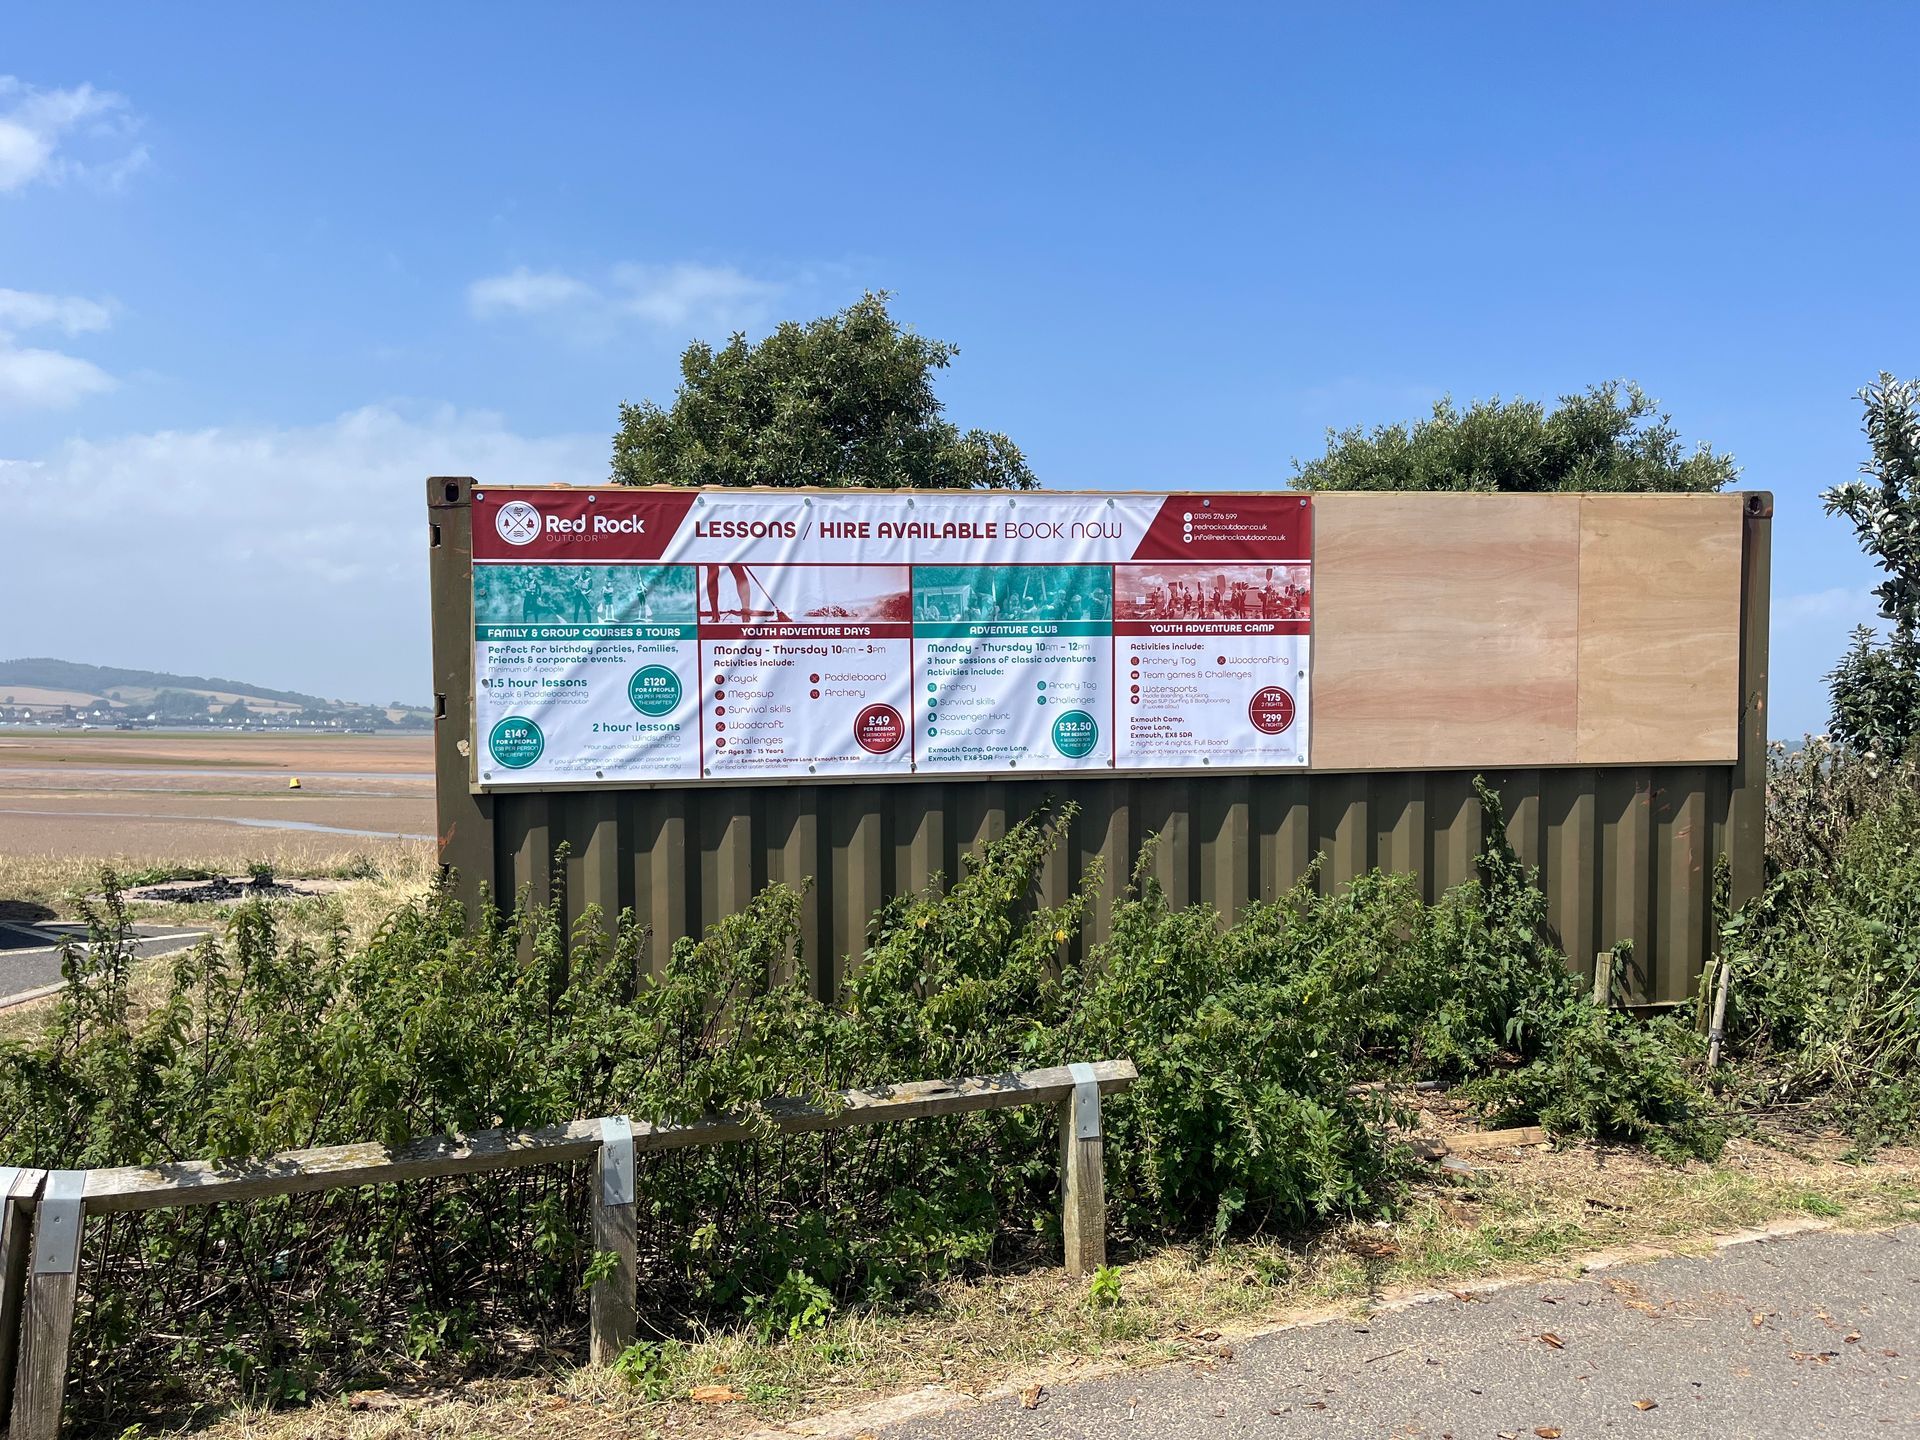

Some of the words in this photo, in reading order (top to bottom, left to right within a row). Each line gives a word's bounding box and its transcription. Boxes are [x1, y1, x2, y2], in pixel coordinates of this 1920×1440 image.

[545, 514, 586, 533] Red
[594, 514, 645, 533] Rock
[695, 521, 796, 539] LESSONS
[820, 521, 870, 539] HIRE
[877, 522, 998, 539] AVAILABLE
[1004, 522, 1064, 539] BOOK
[1071, 522, 1122, 539] NOW
[546, 534, 598, 542] OUTDOOR
[1194, 533, 1286, 541] info@redrockoutdoor.co.uk
[488, 628, 528, 637] FAMILY
[531, 628, 538, 637] &
[541, 628, 580, 637] GROUP
[582, 628, 633, 637] COURSES
[636, 628, 642, 636] &
[645, 628, 681, 636] TOURS
[741, 627, 777, 636] YOUTH
[779, 627, 841, 636] ADVENTURE
[843, 627, 871, 636] DAYS
[969, 626, 1028, 635] ADVENTURE
[1030, 625, 1058, 634] CLUB
[1150, 624, 1183, 633] YOUTH
[1185, 624, 1242, 632] ADVENTURE
[1244, 624, 1275, 632] CAMP
[488, 645, 528, 654] Perfect
[530, 645, 547, 653] for
[549, 645, 593, 655] birthday
[596, 644, 635, 655] parties,
[637, 644, 679, 653] families,
[713, 645, 762, 657] Monday
[772, 645, 828, 656] Thursday
[927, 643, 972, 654] Monday
[981, 642, 1033, 653] Thursday
[488, 656, 525, 664] friends
[527, 656, 533, 664] &
[536, 655, 588, 665] corporate
[590, 655, 626, 663] events.
[713, 659, 758, 667] Activities
[760, 658, 795, 666] include:
[927, 657, 932, 665] 3
[934, 656, 957, 664] hour
[959, 655, 996, 664] sessions
[998, 655, 1009, 664] of
[1011, 655, 1042, 663] classic
[1044, 655, 1097, 663] adventures
[1142, 657, 1178, 666] Archery
[1180, 656, 1196, 666] Tag
[1228, 655, 1289, 665] Woodcrafting
[523, 665, 532, 673] of
[540, 665, 564, 674] people
[927, 668, 969, 676] Activities
[970, 667, 1004, 675] include:
[727, 674, 758, 684] Kayak
[824, 673, 887, 681] Paddleboard
[1142, 671, 1165, 679] Team
[1166, 672, 1196, 680] games
[1204, 670, 1252, 680] Challenges
[488, 678, 505, 688] 1.5
[508, 677, 538, 688] hour
[542, 677, 588, 687] lessons
[643, 677, 667, 687] £120
[1048, 681, 1080, 690] Arcery
[1082, 681, 1097, 690] Tag
[939, 683, 977, 692] Archery
[1142, 685, 1198, 694] Watersports
[489, 691, 515, 699] Kayak
[523, 690, 589, 699] Paddleboarding
[728, 690, 774, 700] Megasup
[824, 688, 866, 698] Archery
[1263, 693, 1281, 702] £175
[939, 698, 974, 706] Survival
[976, 697, 996, 705] skills
[1048, 696, 1096, 705] Challenges
[728, 705, 768, 714] Survival
[769, 705, 792, 714] skills
[868, 715, 890, 726] £49
[939, 713, 987, 722] Scavenger
[988, 712, 1011, 720] Hunt
[1262, 713, 1282, 722] £299
[592, 723, 599, 732] 2
[602, 722, 632, 732] hour
[636, 721, 680, 731] lessons
[729, 720, 784, 729] Woodcraft
[1059, 721, 1092, 731] £32.50
[504, 729, 528, 738] £149
[940, 728, 972, 736] Assault
[974, 727, 1006, 735] Course
[632, 734, 681, 743] Windsurfing
[729, 736, 784, 747] Challenges
[961, 746, 985, 754] Camp,
[928, 754, 962, 762] Exmouth,
